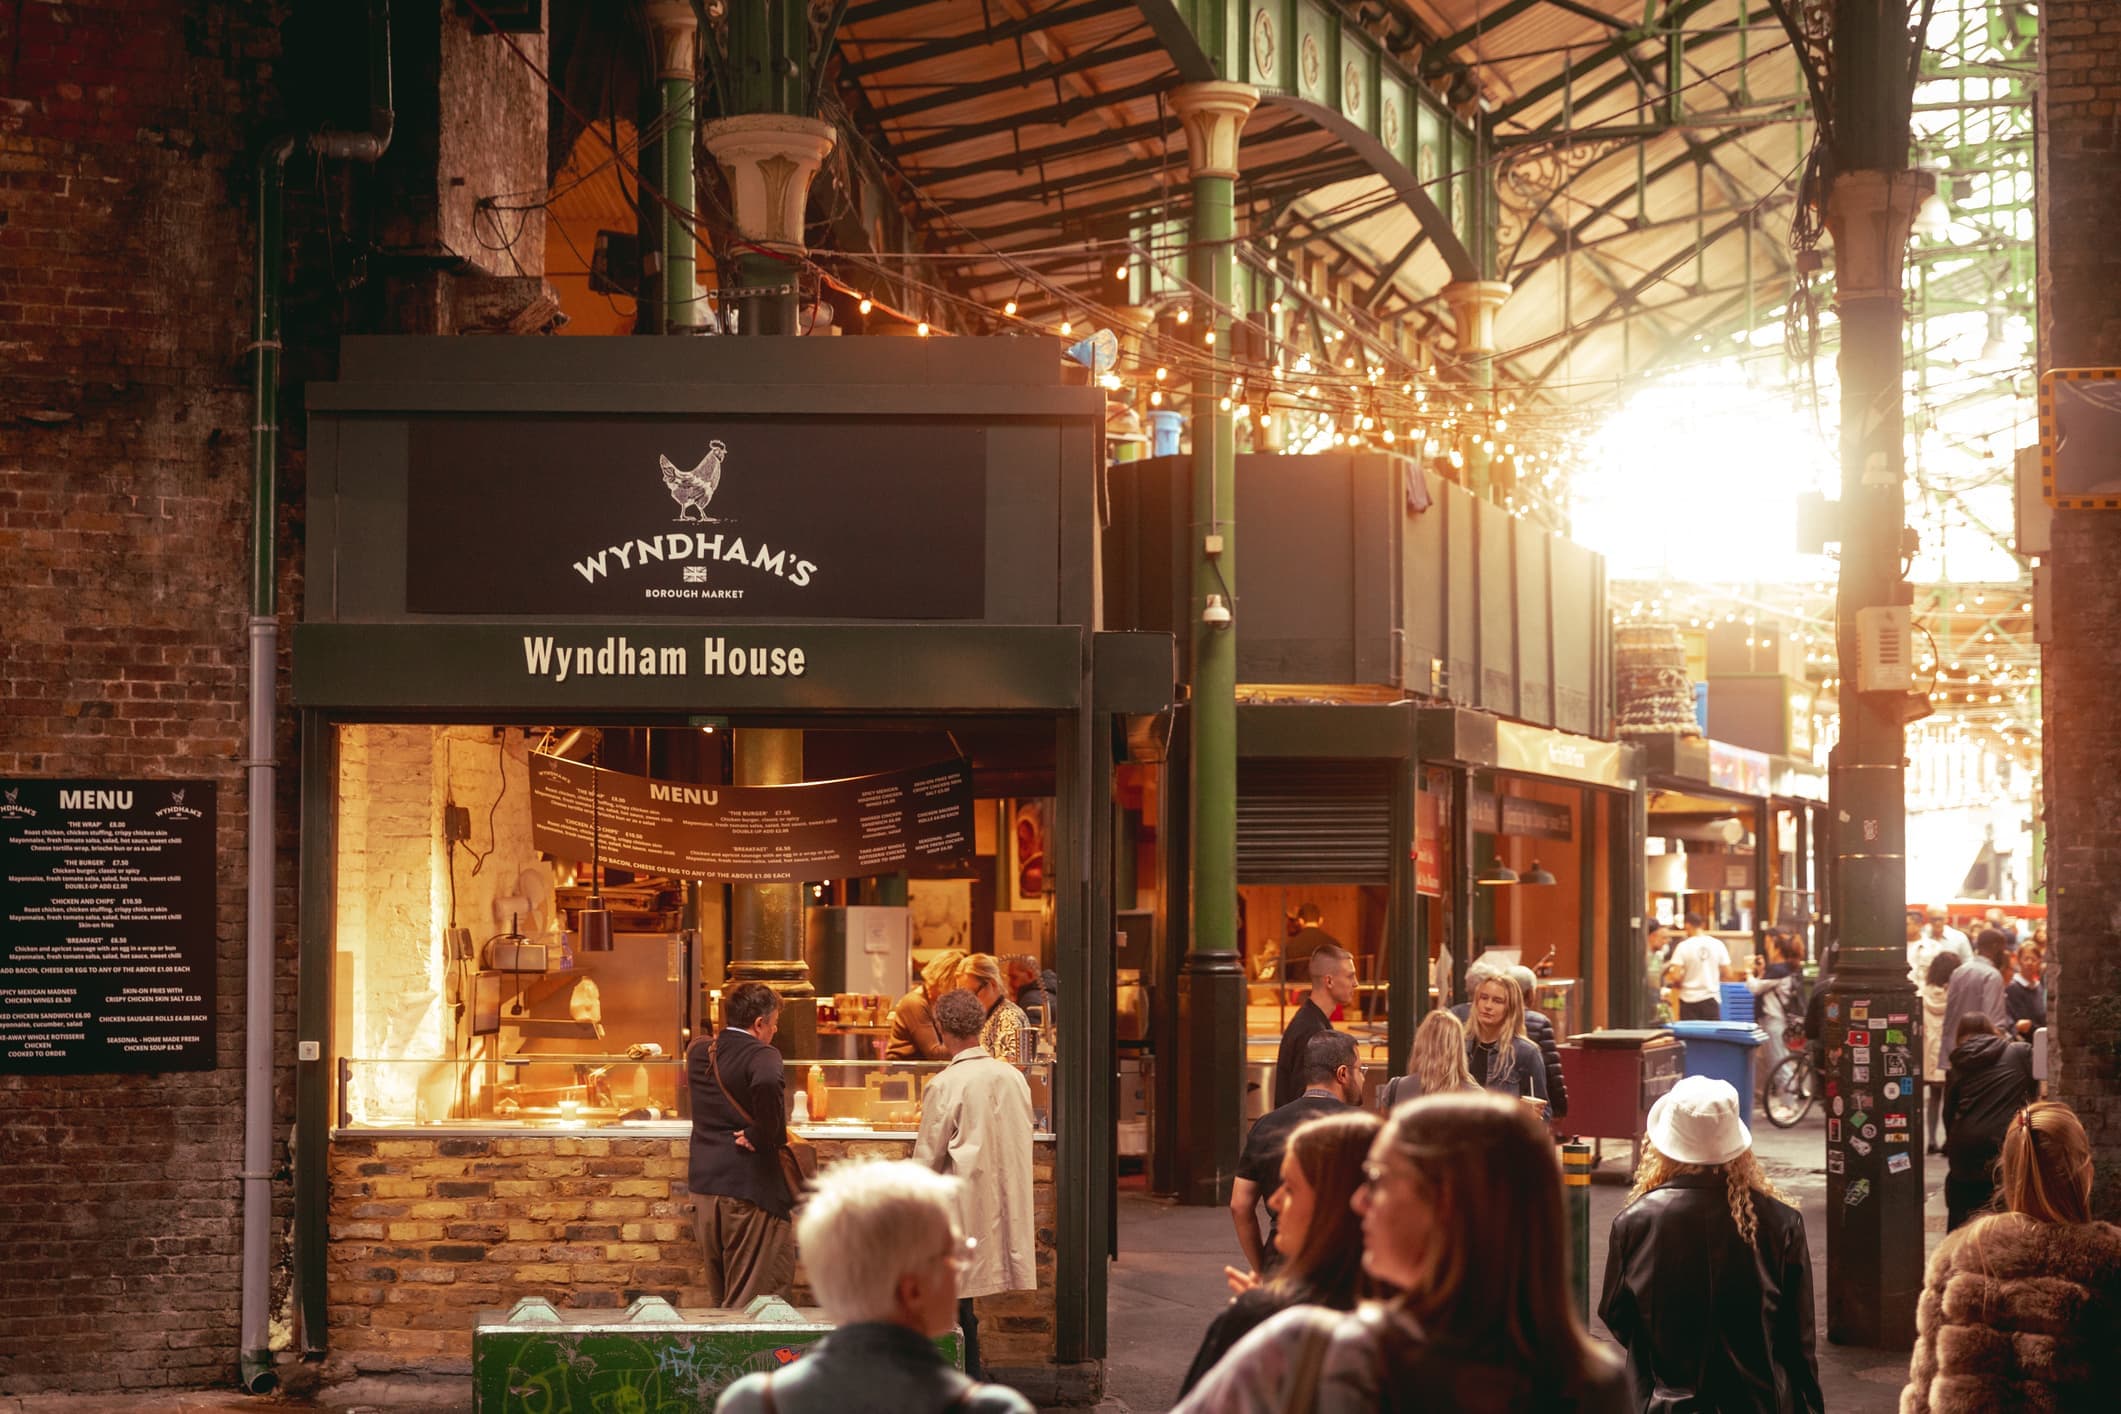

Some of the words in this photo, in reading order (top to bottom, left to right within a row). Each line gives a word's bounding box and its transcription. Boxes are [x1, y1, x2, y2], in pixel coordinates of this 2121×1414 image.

[573, 533, 817, 586] WYNDHAM'S
[646, 589, 698, 598] BOROUGH
[702, 590, 744, 598] MARKET
[524, 637, 687, 682] Wyndham
[705, 638, 805, 676] House
[59, 790, 134, 810] MENU
[650, 783, 719, 806] MENU
[156, 806, 202, 818] WYNDHAM'S
